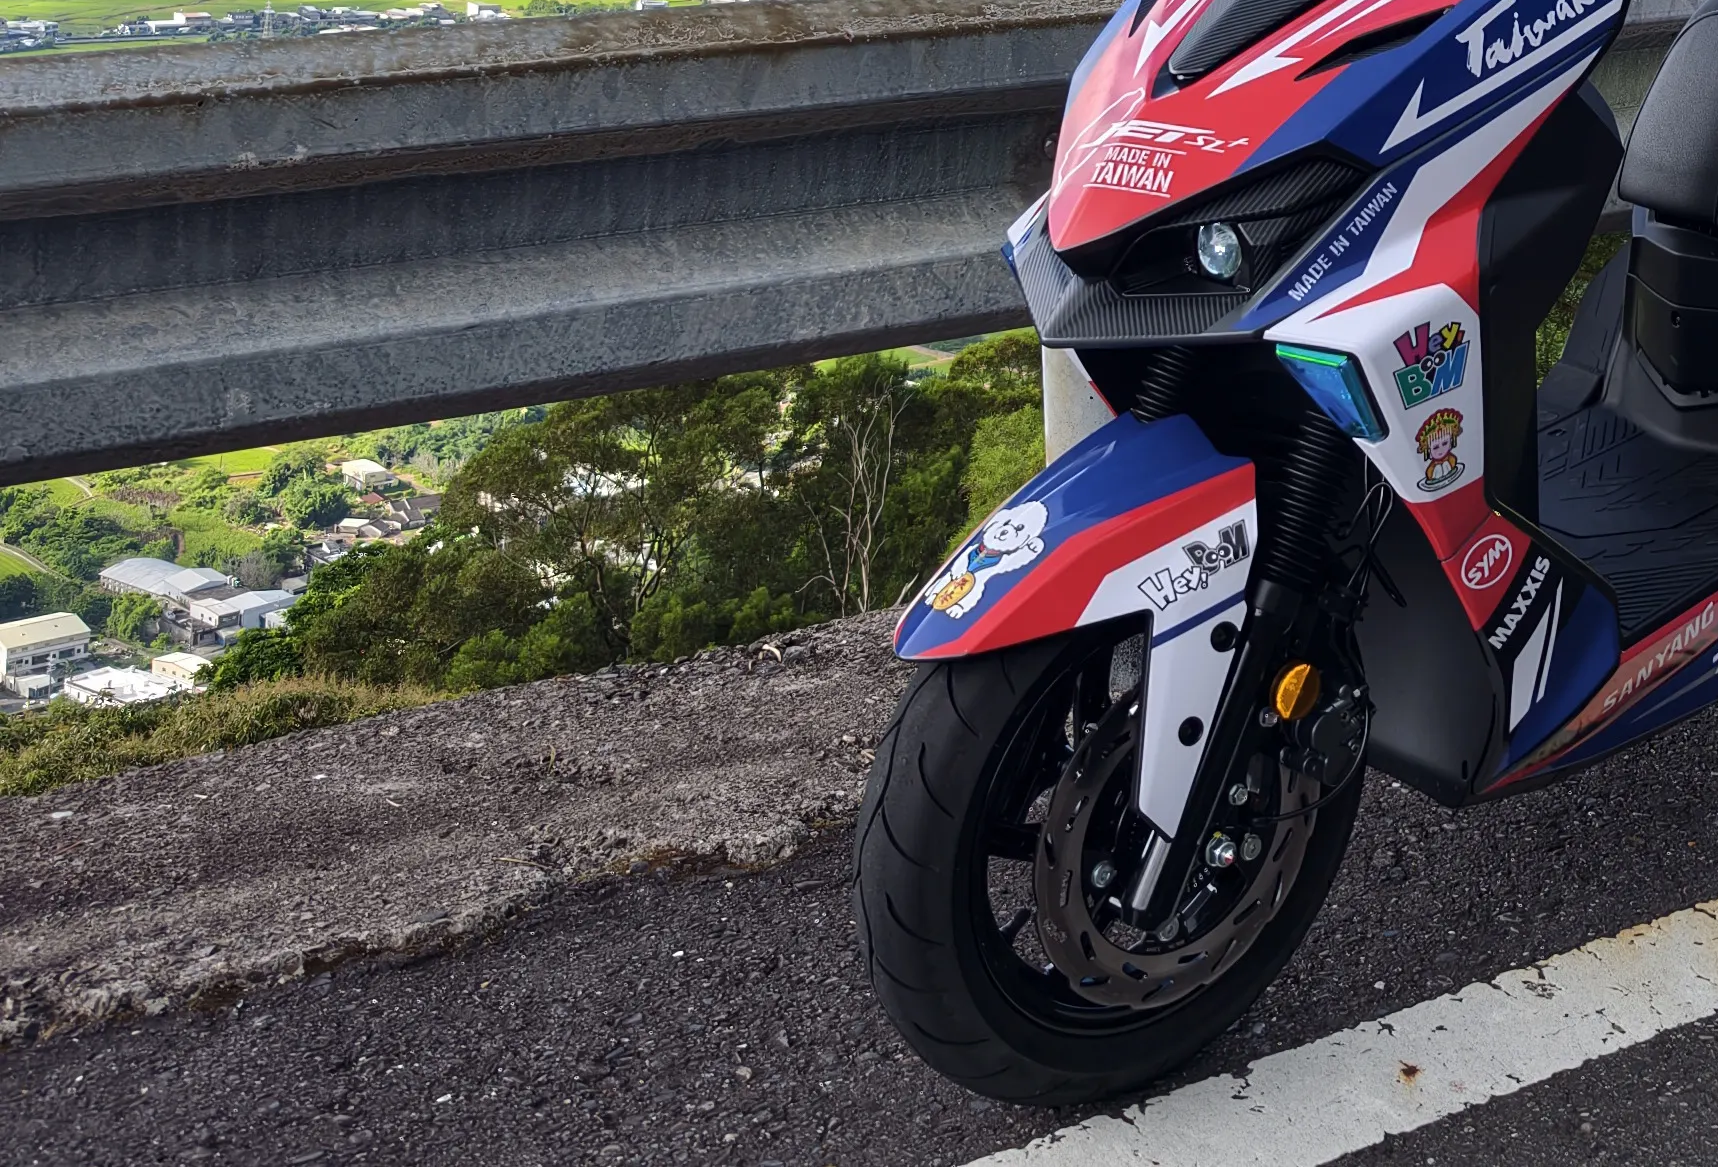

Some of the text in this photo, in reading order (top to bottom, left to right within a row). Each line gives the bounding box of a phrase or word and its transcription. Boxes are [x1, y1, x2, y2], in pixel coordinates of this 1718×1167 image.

[1089, 161, 1175, 193] TAIWAN
[1103, 146, 1173, 169] MADE IN
[1286, 181, 1399, 303] MADE IN TAIWAN
[1466, 538, 1510, 587] SYM
[1137, 565, 1209, 612] Hey!
[1487, 555, 1551, 650] MAXXIS
[1601, 600, 1716, 715] SANYANG
